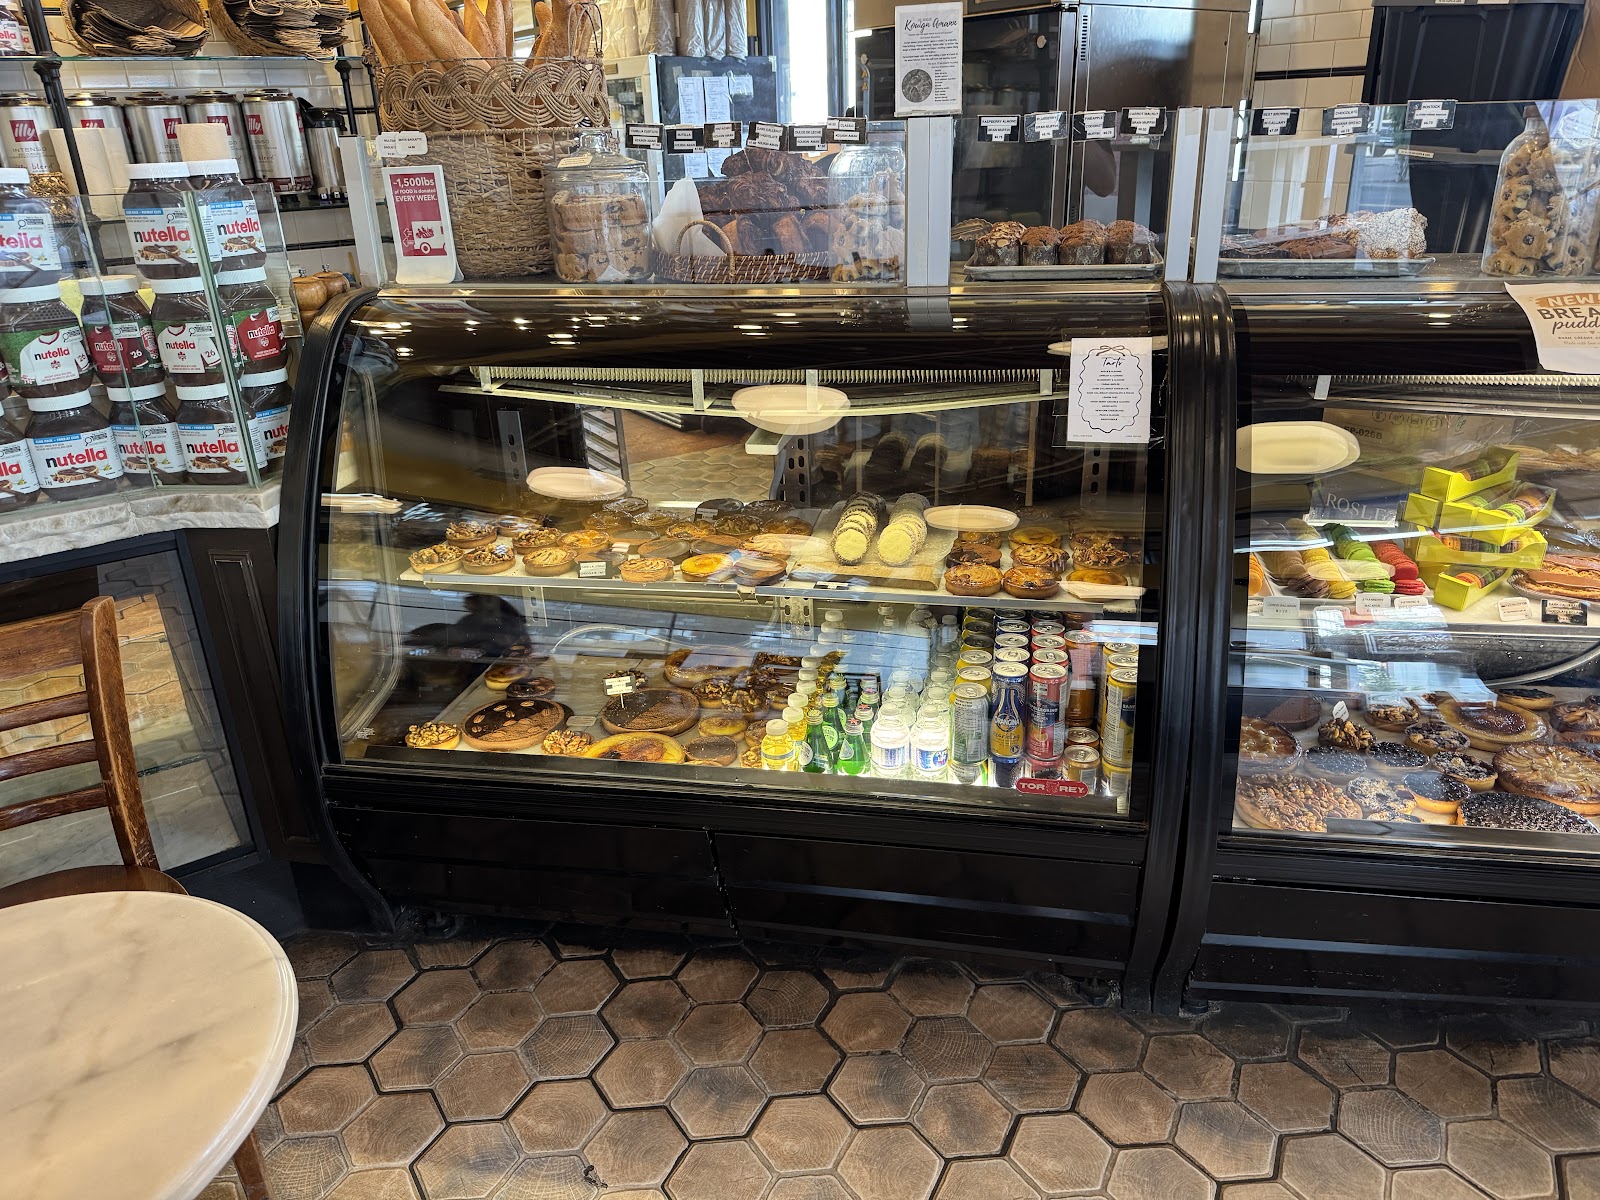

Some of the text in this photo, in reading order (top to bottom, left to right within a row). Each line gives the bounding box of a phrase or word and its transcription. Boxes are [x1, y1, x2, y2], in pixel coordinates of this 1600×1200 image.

[15, 123, 35, 140] illy
[248, 117, 261, 134] illy
[416, 194, 438, 202] WEEK.
[217, 217, 260, 236] nutella
[133, 225, 191, 243] nutella
[248, 325, 275, 339] nutella
[94, 340, 124, 351] nutel
[165, 340, 196, 350] nutella
[34, 347, 71, 361] nutella
[186, 439, 240, 454] nutella
[45, 447, 108, 468] nutella
[1019, 782, 1085, 793] TOR REY
